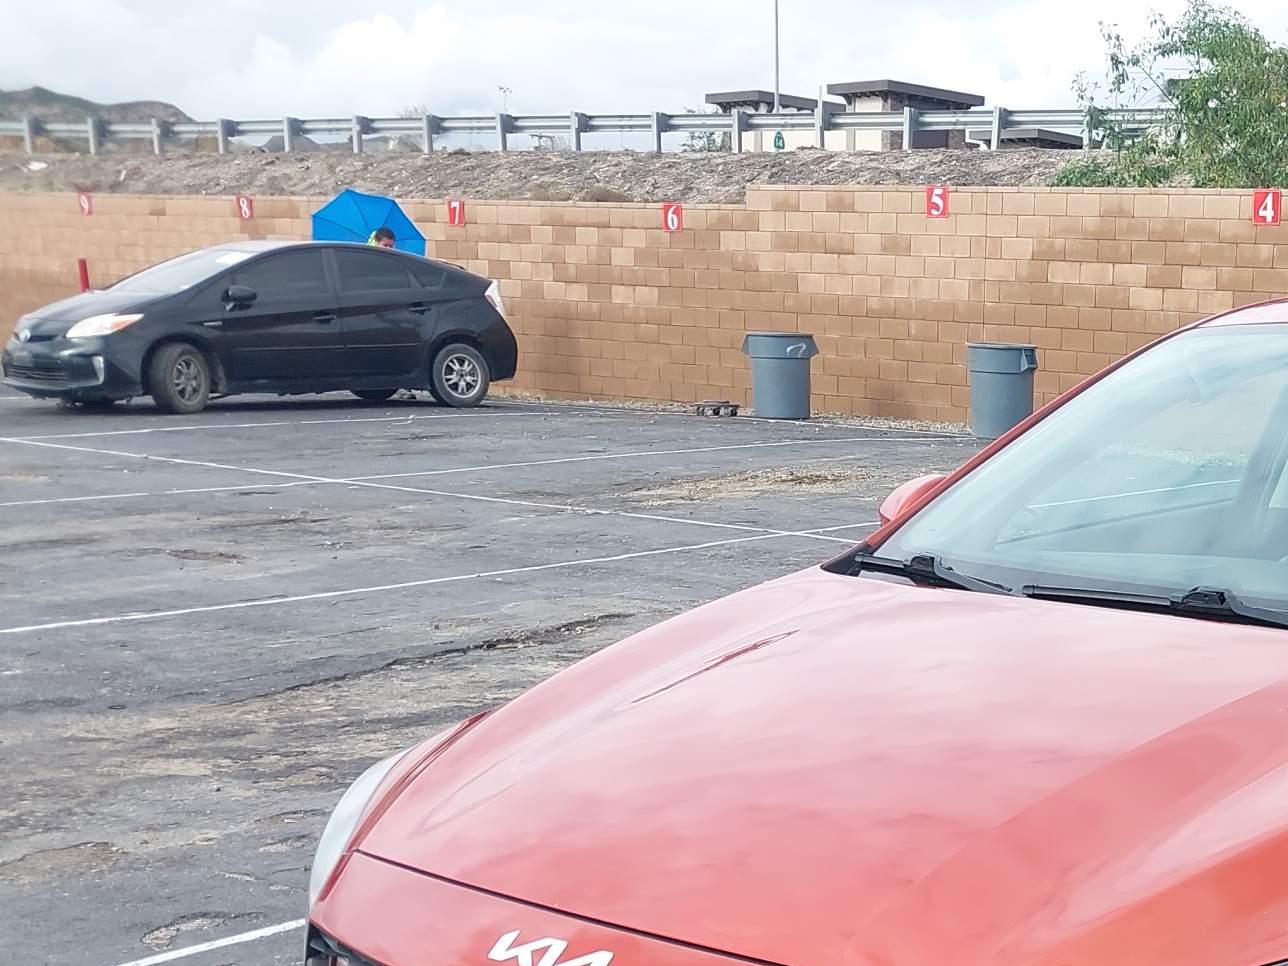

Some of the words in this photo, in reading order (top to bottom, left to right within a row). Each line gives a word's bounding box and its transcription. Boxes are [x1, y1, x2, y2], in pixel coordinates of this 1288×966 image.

[79, 194, 89, 215] 9
[239, 197, 250, 218] 8
[450, 201, 460, 225] 7
[930, 188, 945, 216] 5
[1258, 192, 1275, 223] 4
[667, 205, 679, 230] 6
